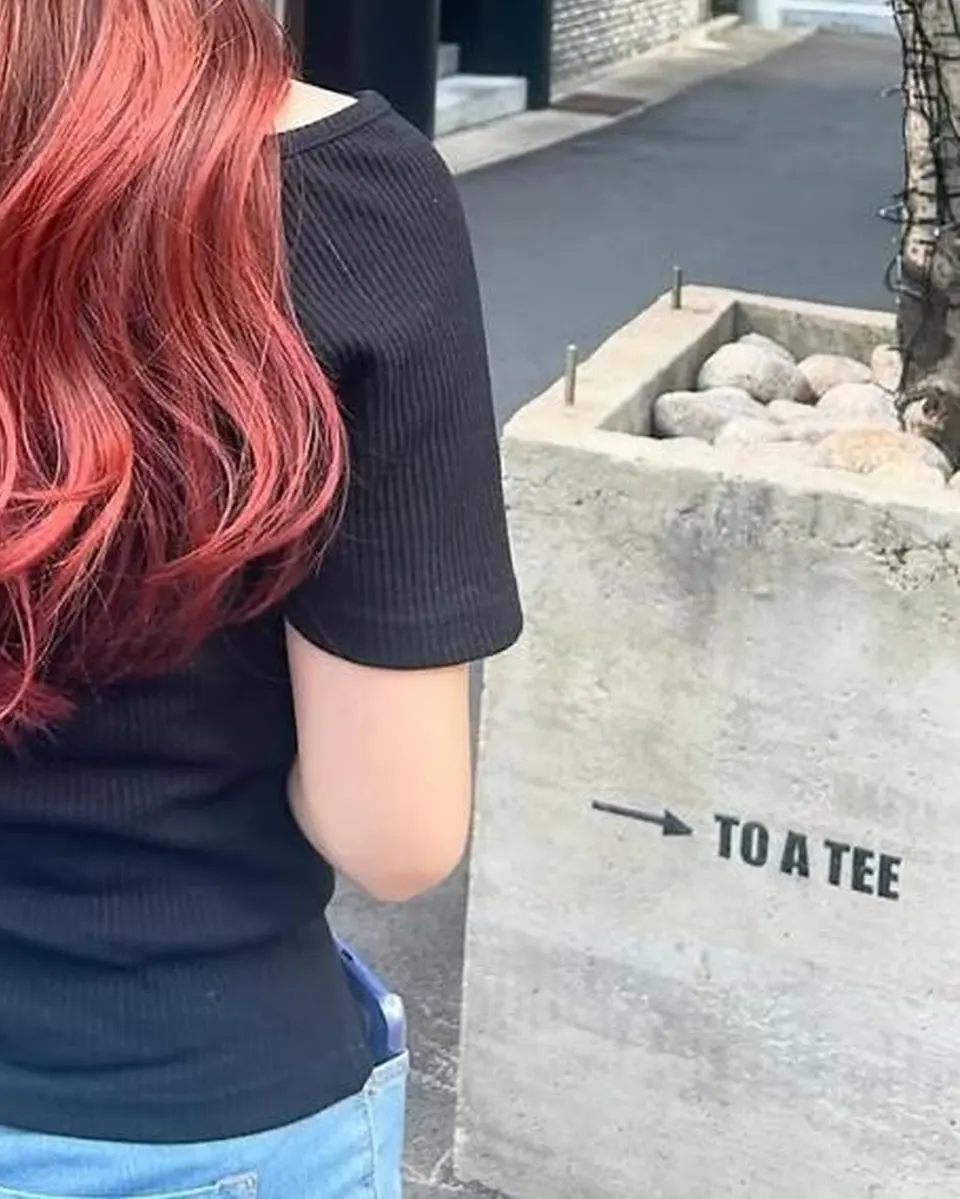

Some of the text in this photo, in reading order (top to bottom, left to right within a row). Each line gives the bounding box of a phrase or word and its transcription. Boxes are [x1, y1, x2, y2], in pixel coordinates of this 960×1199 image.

[714, 813, 902, 900] TO A TEE
